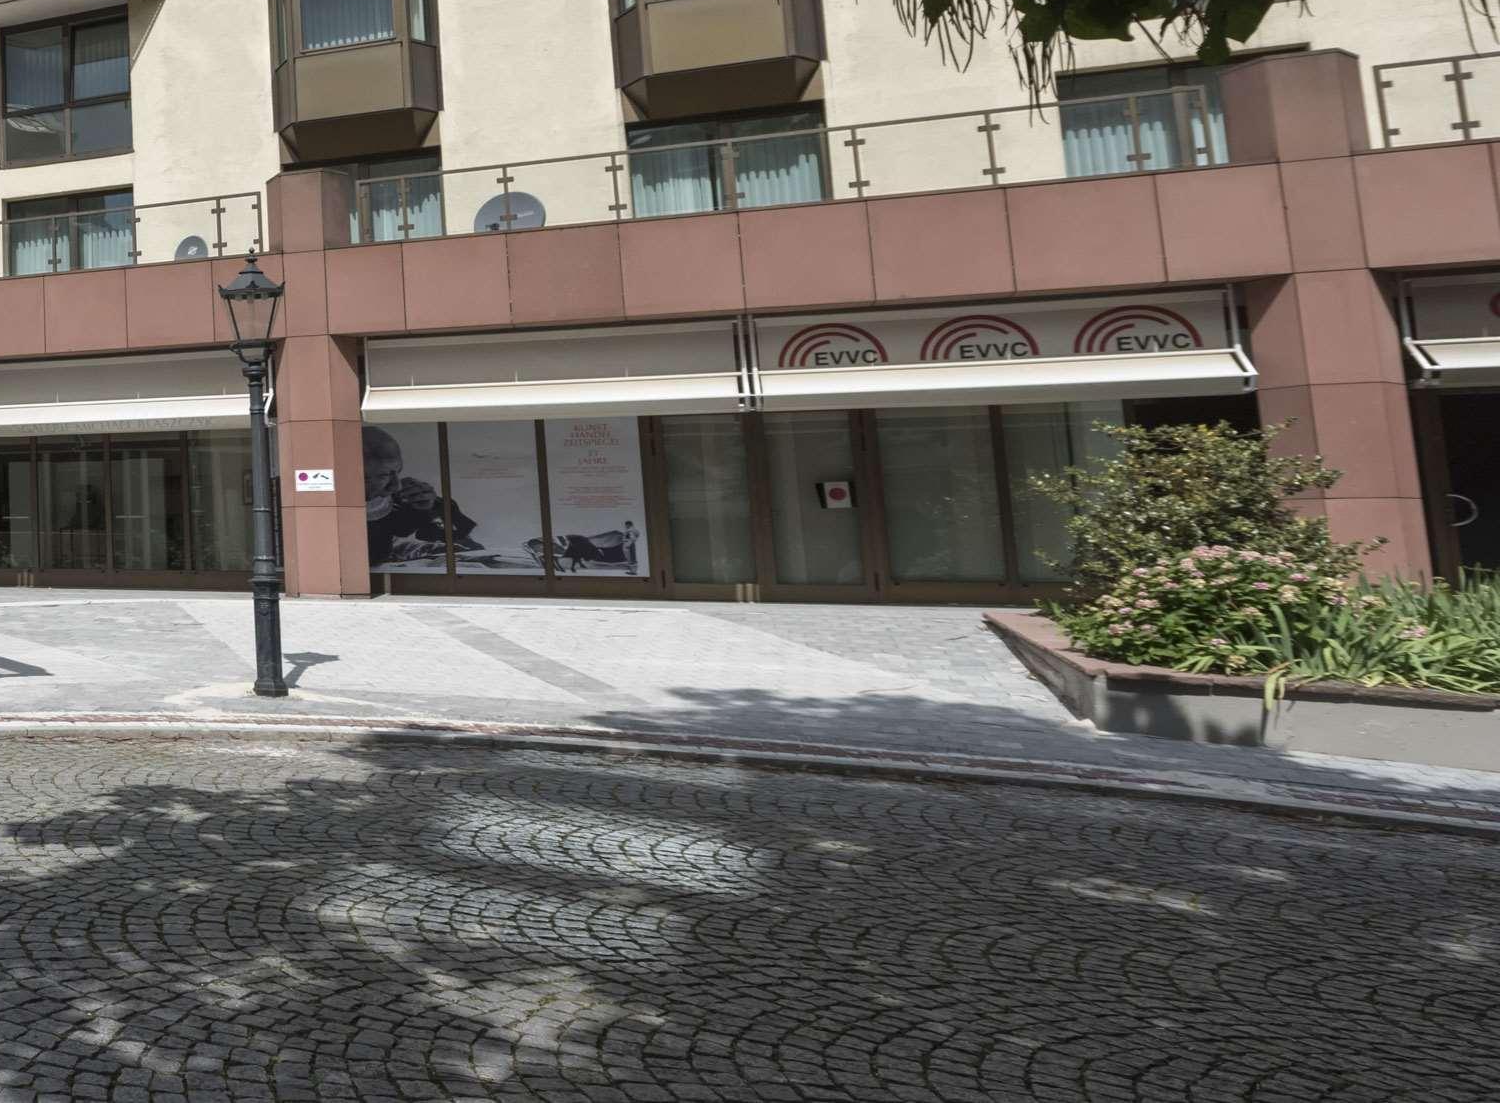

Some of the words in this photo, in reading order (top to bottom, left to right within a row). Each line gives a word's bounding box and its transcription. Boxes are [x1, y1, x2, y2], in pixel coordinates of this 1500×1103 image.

[960, 341, 1029, 360] EVVC
[1116, 332, 1192, 352] EVVC
[814, 348, 879, 367] EVVC
